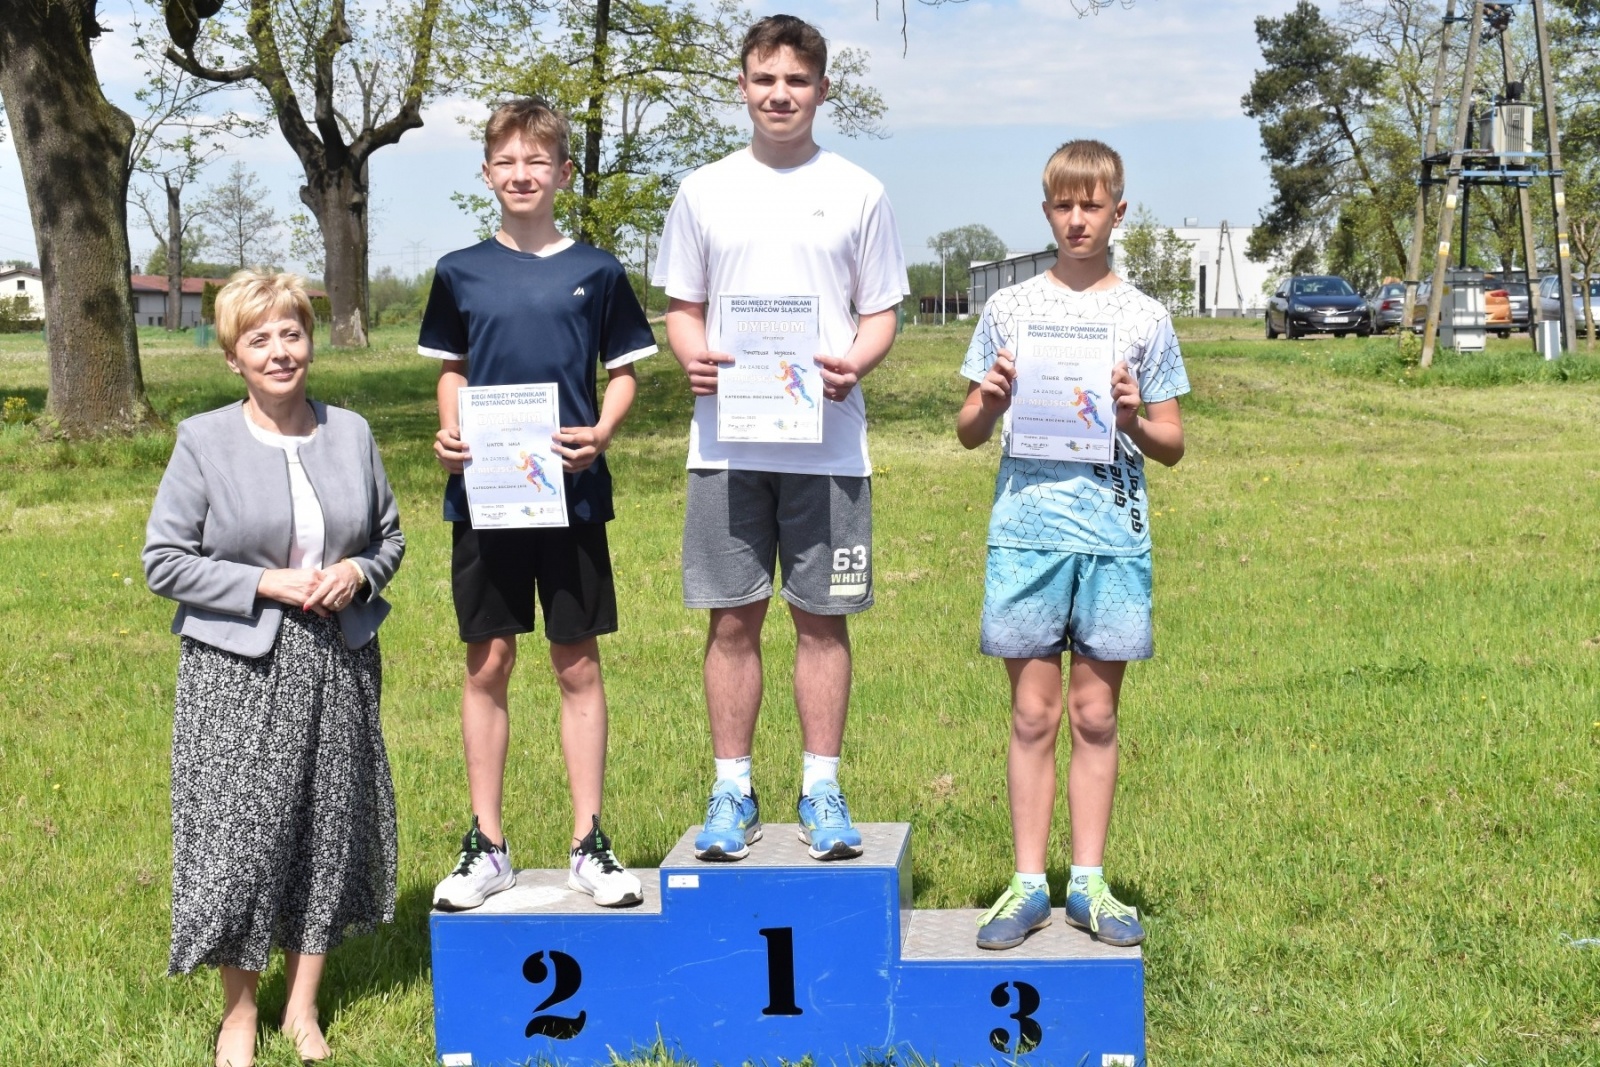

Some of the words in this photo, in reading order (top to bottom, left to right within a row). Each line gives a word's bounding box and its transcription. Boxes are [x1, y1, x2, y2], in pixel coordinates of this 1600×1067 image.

[781, 306, 812, 314] ŚLĄSKICH
[737, 321, 806, 333] DYPLOM
[1033, 345, 1101, 359] DYPLOM
[477, 412, 542, 425] DYPLOM
[1131, 507, 1143, 533] GO
[833, 545, 867, 571] 63
[831, 572, 867, 584] WHITE
[759, 926, 803, 1016] 1
[522, 950, 587, 1040] 2
[989, 980, 1043, 1055] 3
